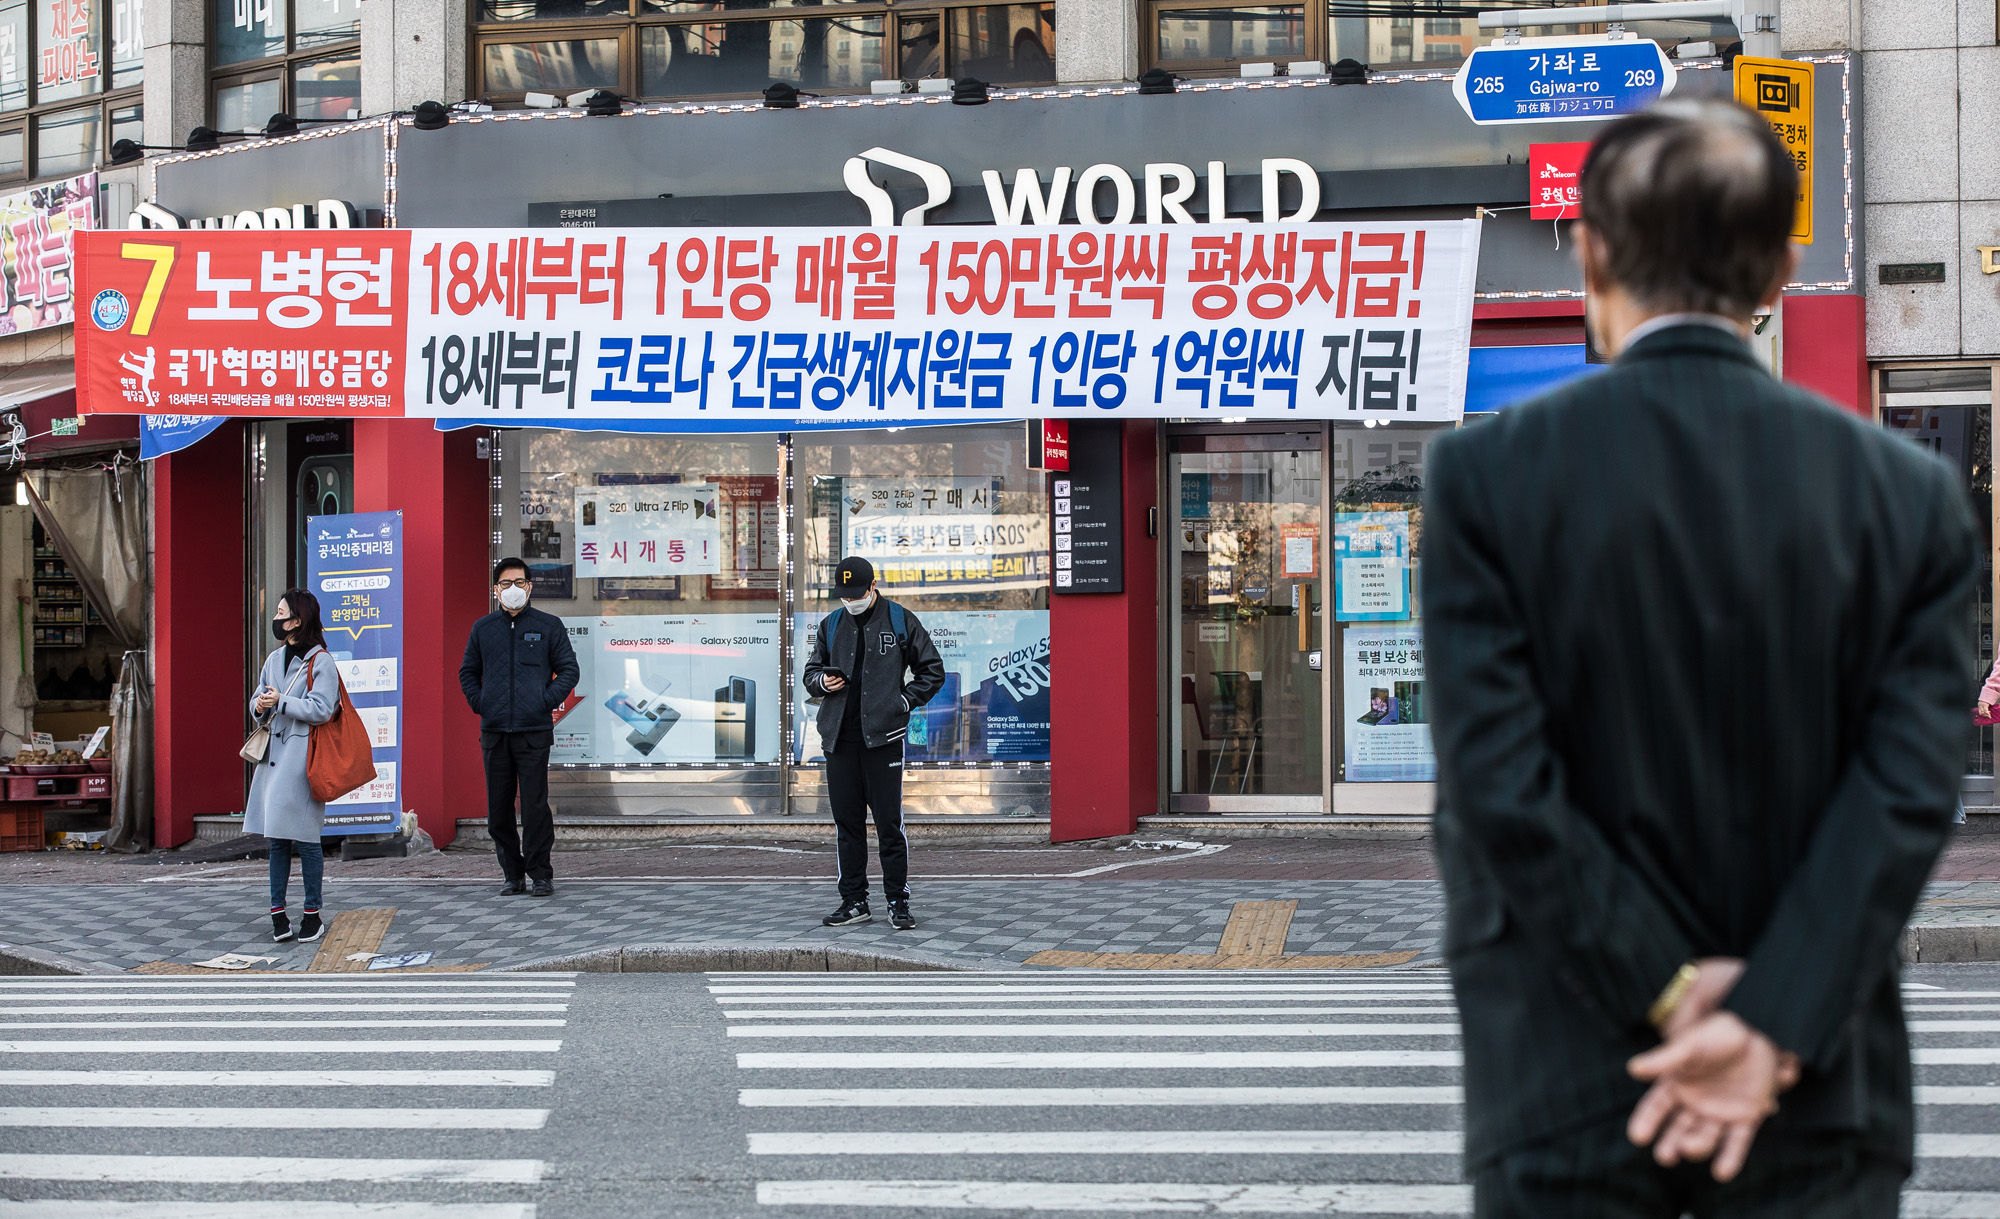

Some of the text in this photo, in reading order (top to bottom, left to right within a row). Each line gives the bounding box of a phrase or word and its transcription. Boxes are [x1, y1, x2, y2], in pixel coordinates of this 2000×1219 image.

[51, 0, 88, 40] 재즈
[43, 39, 98, 87] 피아노
[1528, 52, 1601, 75] 가좌로
[1473, 76, 1505, 95] 265
[1624, 69, 1656, 88] 269
[1529, 79, 1600, 96] Gajwa-ro
[1516, 102, 1551, 115] 加佐路
[1557, 99, 1615, 112] カジュワロ
[1767, 122, 1808, 146] 주정차
[1540, 170, 1551, 178] SK
[981, 157, 1321, 227] WORLD
[560, 208, 596, 219] 은평대리점
[560, 220, 596, 228] 3046-011
[421, 230, 1427, 322] 18세부터 1인당 매월 150만원씩 평생지급!
[121, 242, 176, 336] 7
[187, 247, 394, 330] 노병현
[99, 304, 120, 318] 선거
[168, 346, 392, 388] 국가혁명배당금당
[421, 327, 1422, 412] 18세부터 코로나 긴급생계지원금 1인당 1억원씩 지급!
[120, 377, 136, 390] 혁명
[168, 394, 391, 407] 18세부터 국민배당금을 매월 150만원씩 평생지급!
[872, 490, 914, 500] S20 Z Flip
[609, 500, 689, 514] S20 Ultra Z Flip
[896, 500, 913, 509] Fold
[318, 540, 393, 559] 공식인증대리점
[842, 570, 852, 584] P
[340, 594, 370, 606] 고객님
[331, 607, 380, 622] 환영합니다
[610, 637, 674, 648] Galaxy S20 S20+
[700, 637, 731, 646] Galaxy
[749, 636, 769, 644] Ultra
[879, 631, 896, 655] P
[989, 644, 1037, 672] Galaxy
[1358, 650, 1381, 664] 특별
[1384, 650, 1408, 664] 보상
[1359, 668, 1373, 677] 최대
[1374, 668, 1400, 676] 2배까지
